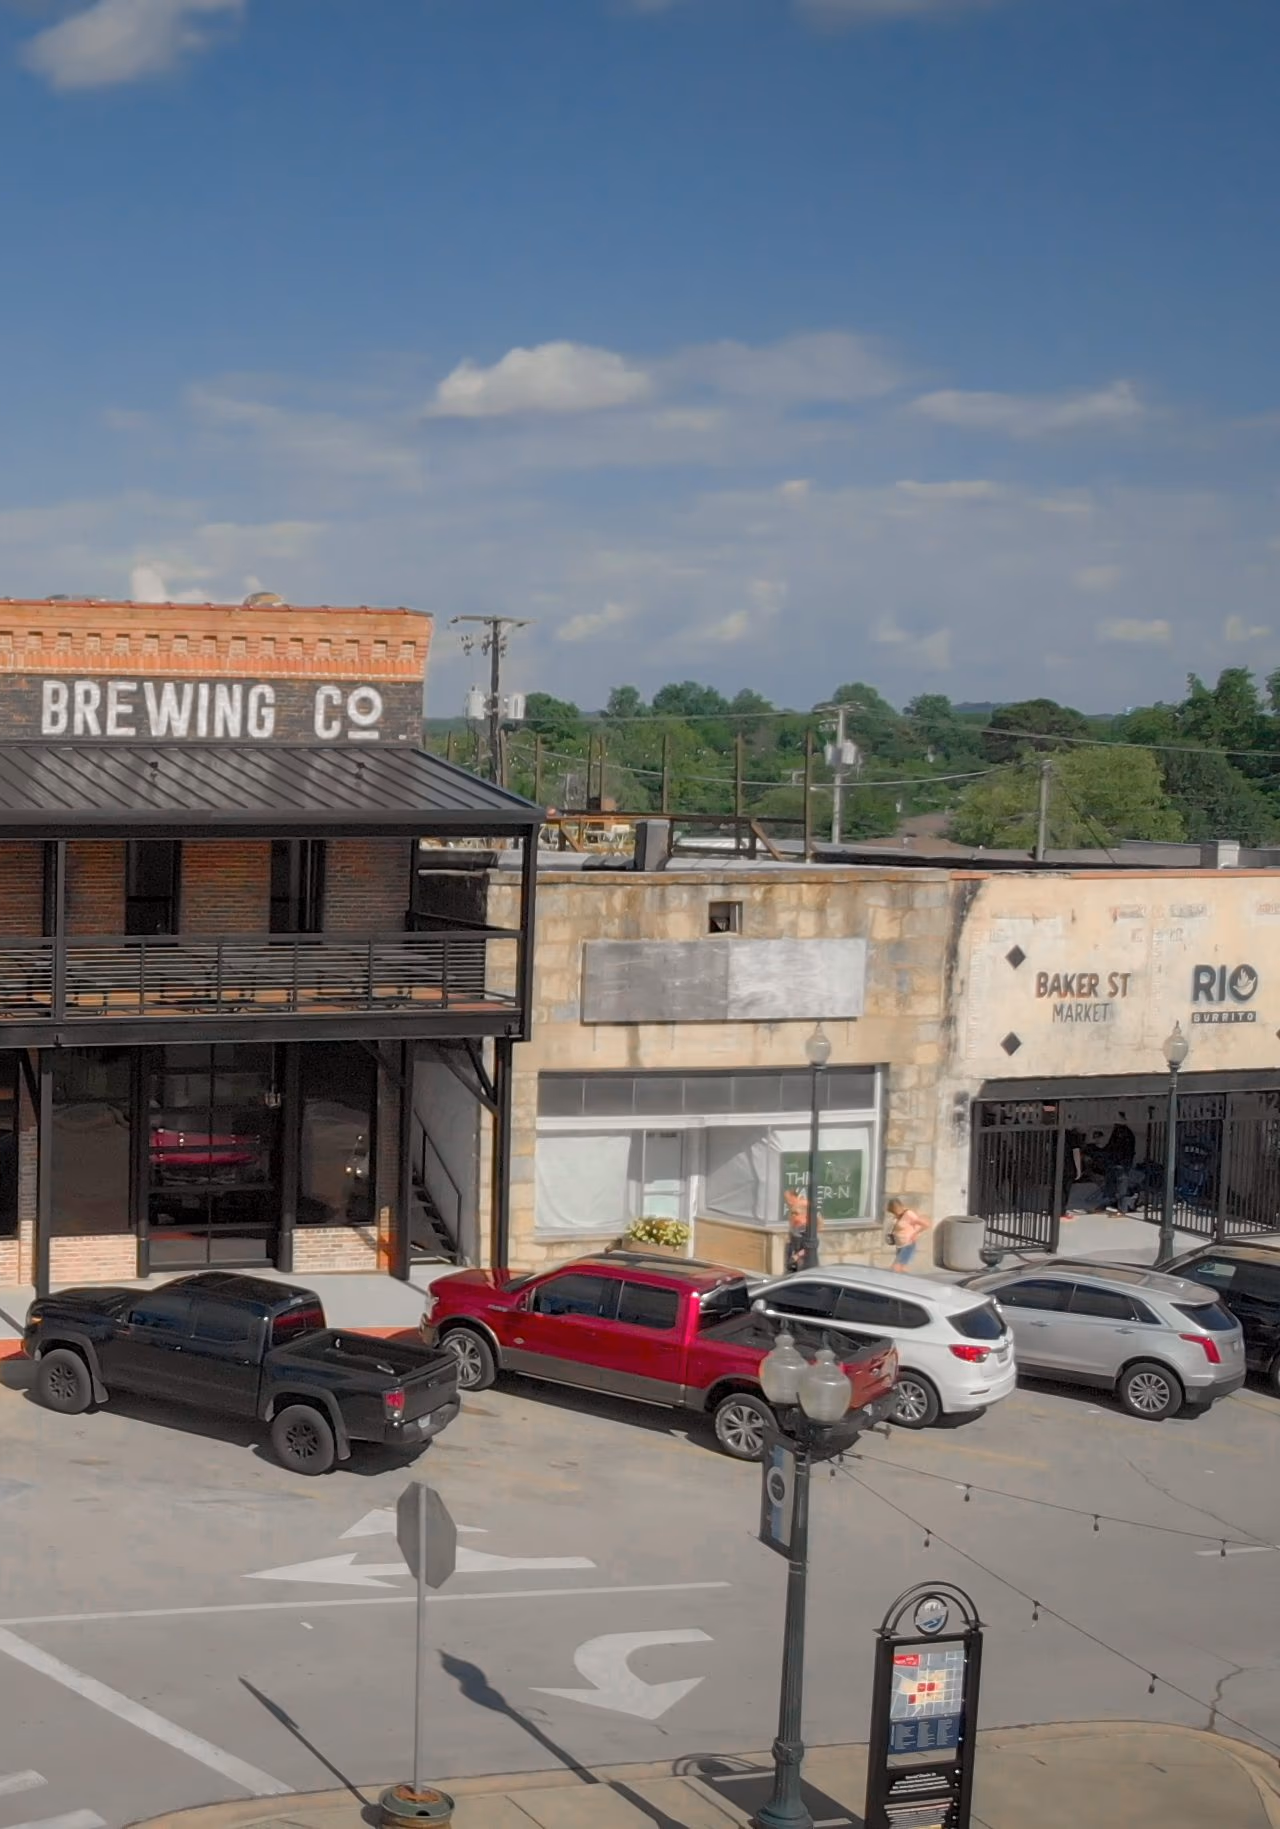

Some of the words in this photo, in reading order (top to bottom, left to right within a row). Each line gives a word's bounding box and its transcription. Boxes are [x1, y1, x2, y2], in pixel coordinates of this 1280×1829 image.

[41, 680, 276, 739] BREWING
[1035, 971, 1100, 999] BAKER
[1108, 971, 1132, 999] ST
[1192, 963, 1259, 1003] RIO
[1052, 1002, 1111, 1024] MARKET
[1193, 1012, 1255, 1024] BURRITO
[785, 1171, 809, 1185] TH
